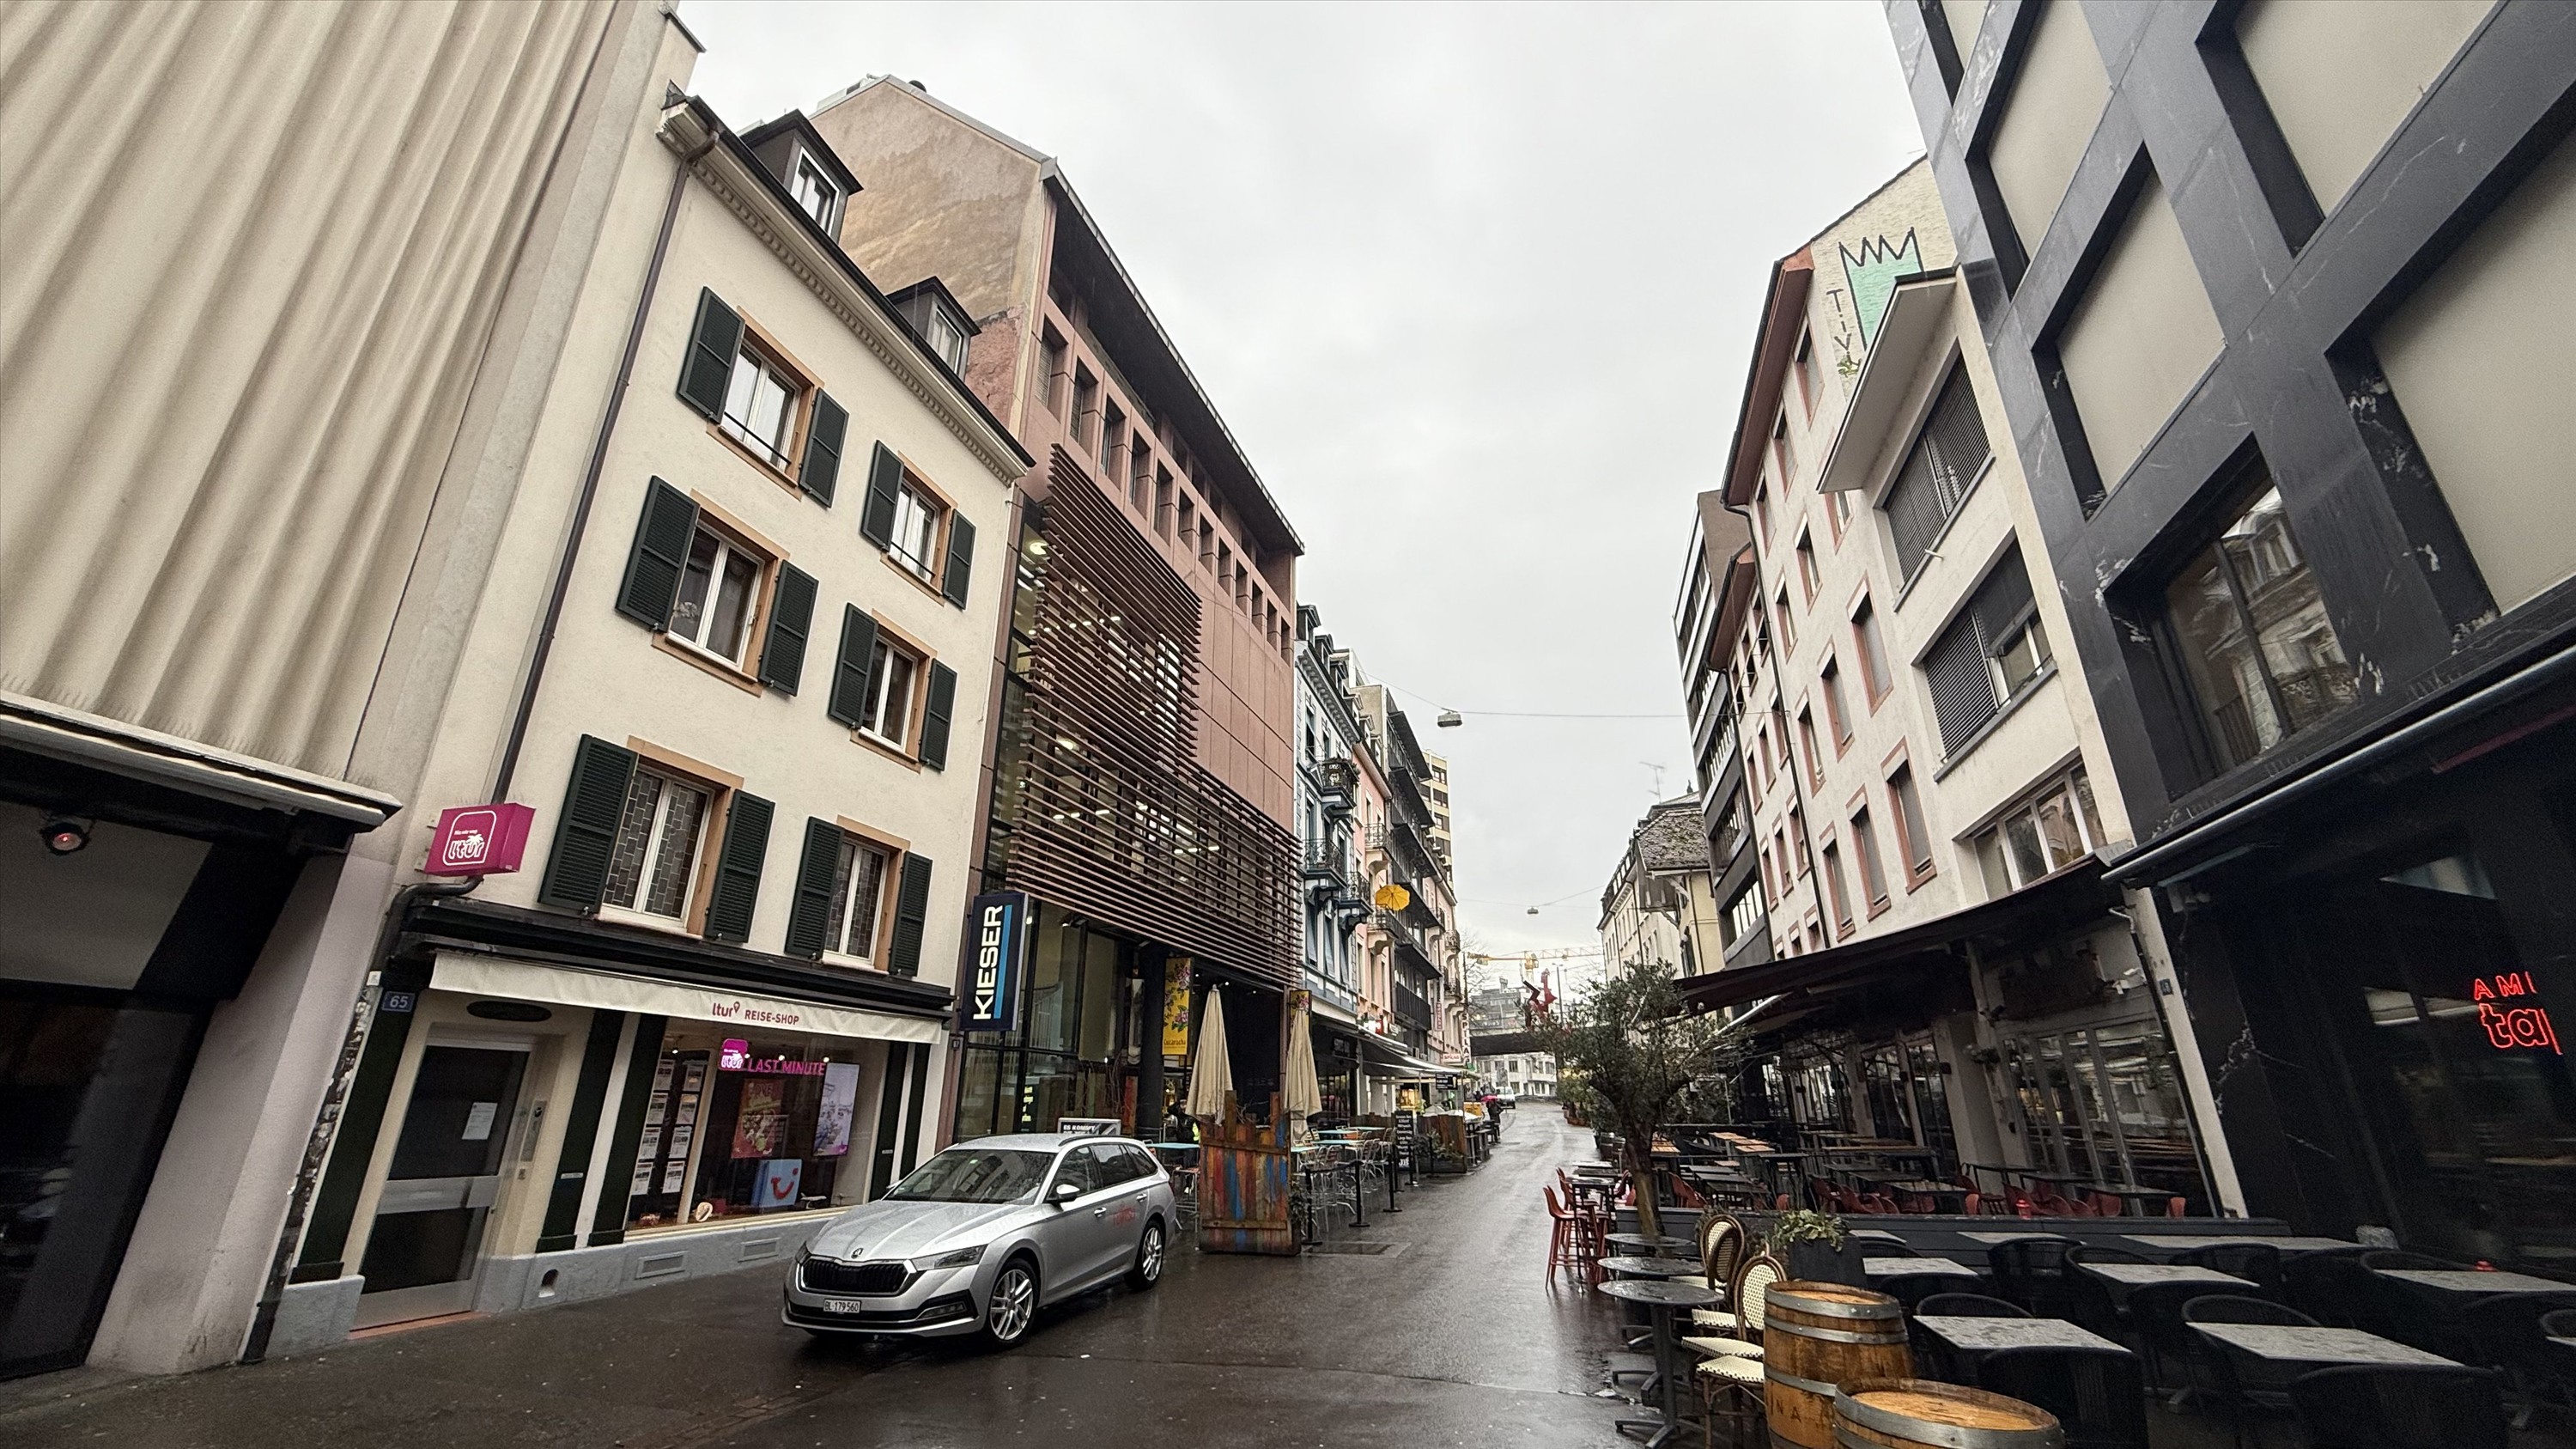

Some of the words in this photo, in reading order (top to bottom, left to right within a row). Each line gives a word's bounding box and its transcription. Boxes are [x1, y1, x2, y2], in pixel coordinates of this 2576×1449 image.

[973, 904, 1003, 1020] KIESER
[390, 995, 408, 1008] 65
[712, 1002, 733, 1018] ltur
[744, 1009, 799, 1026] REISE-SHOP
[747, 1057, 780, 1073] LAST
[781, 1060, 827, 1076] MINUTE
